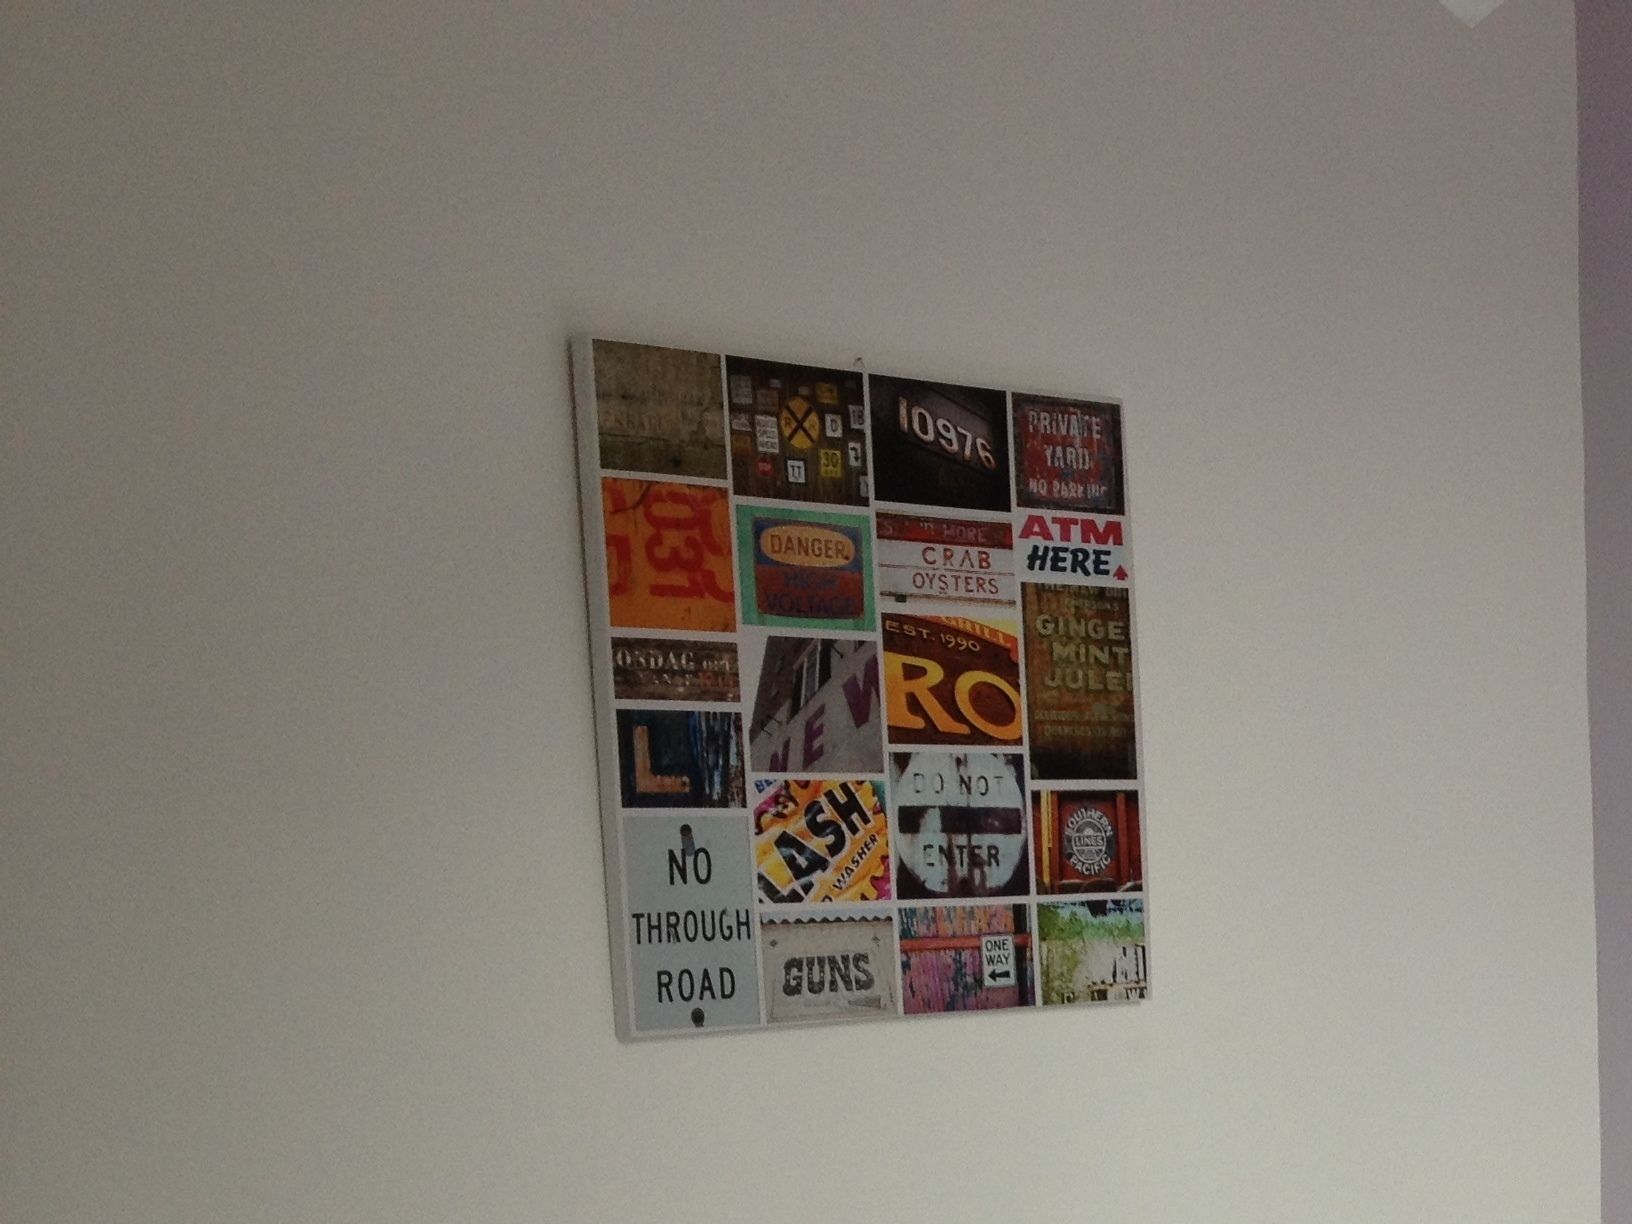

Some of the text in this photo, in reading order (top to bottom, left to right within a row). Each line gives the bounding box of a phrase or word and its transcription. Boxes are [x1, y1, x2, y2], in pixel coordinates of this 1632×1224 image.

[898, 396, 997, 471] 10976
[1028, 409, 1101, 439] PRIVATE
[1043, 443, 1090, 471] YARD
[1018, 513, 1124, 546] ATM
[769, 533, 849, 562] DANGER
[922, 546, 992, 571] CRAB
[1026, 544, 1112, 577] HERE
[912, 571, 999, 595] OYSTERS
[1035, 613, 1127, 641] GINGE
[940, 632, 981, 653] 1990
[1051, 641, 1130, 665] MINT
[667, 846, 712, 886] NO
[923, 843, 1001, 869] ENTER
[631, 907, 752, 945] THROUGH
[984, 953, 1010, 966] WAY
[985, 938, 1010, 953] ONE
[655, 966, 737, 1004] ROAD
[782, 952, 876, 998] GUNS
